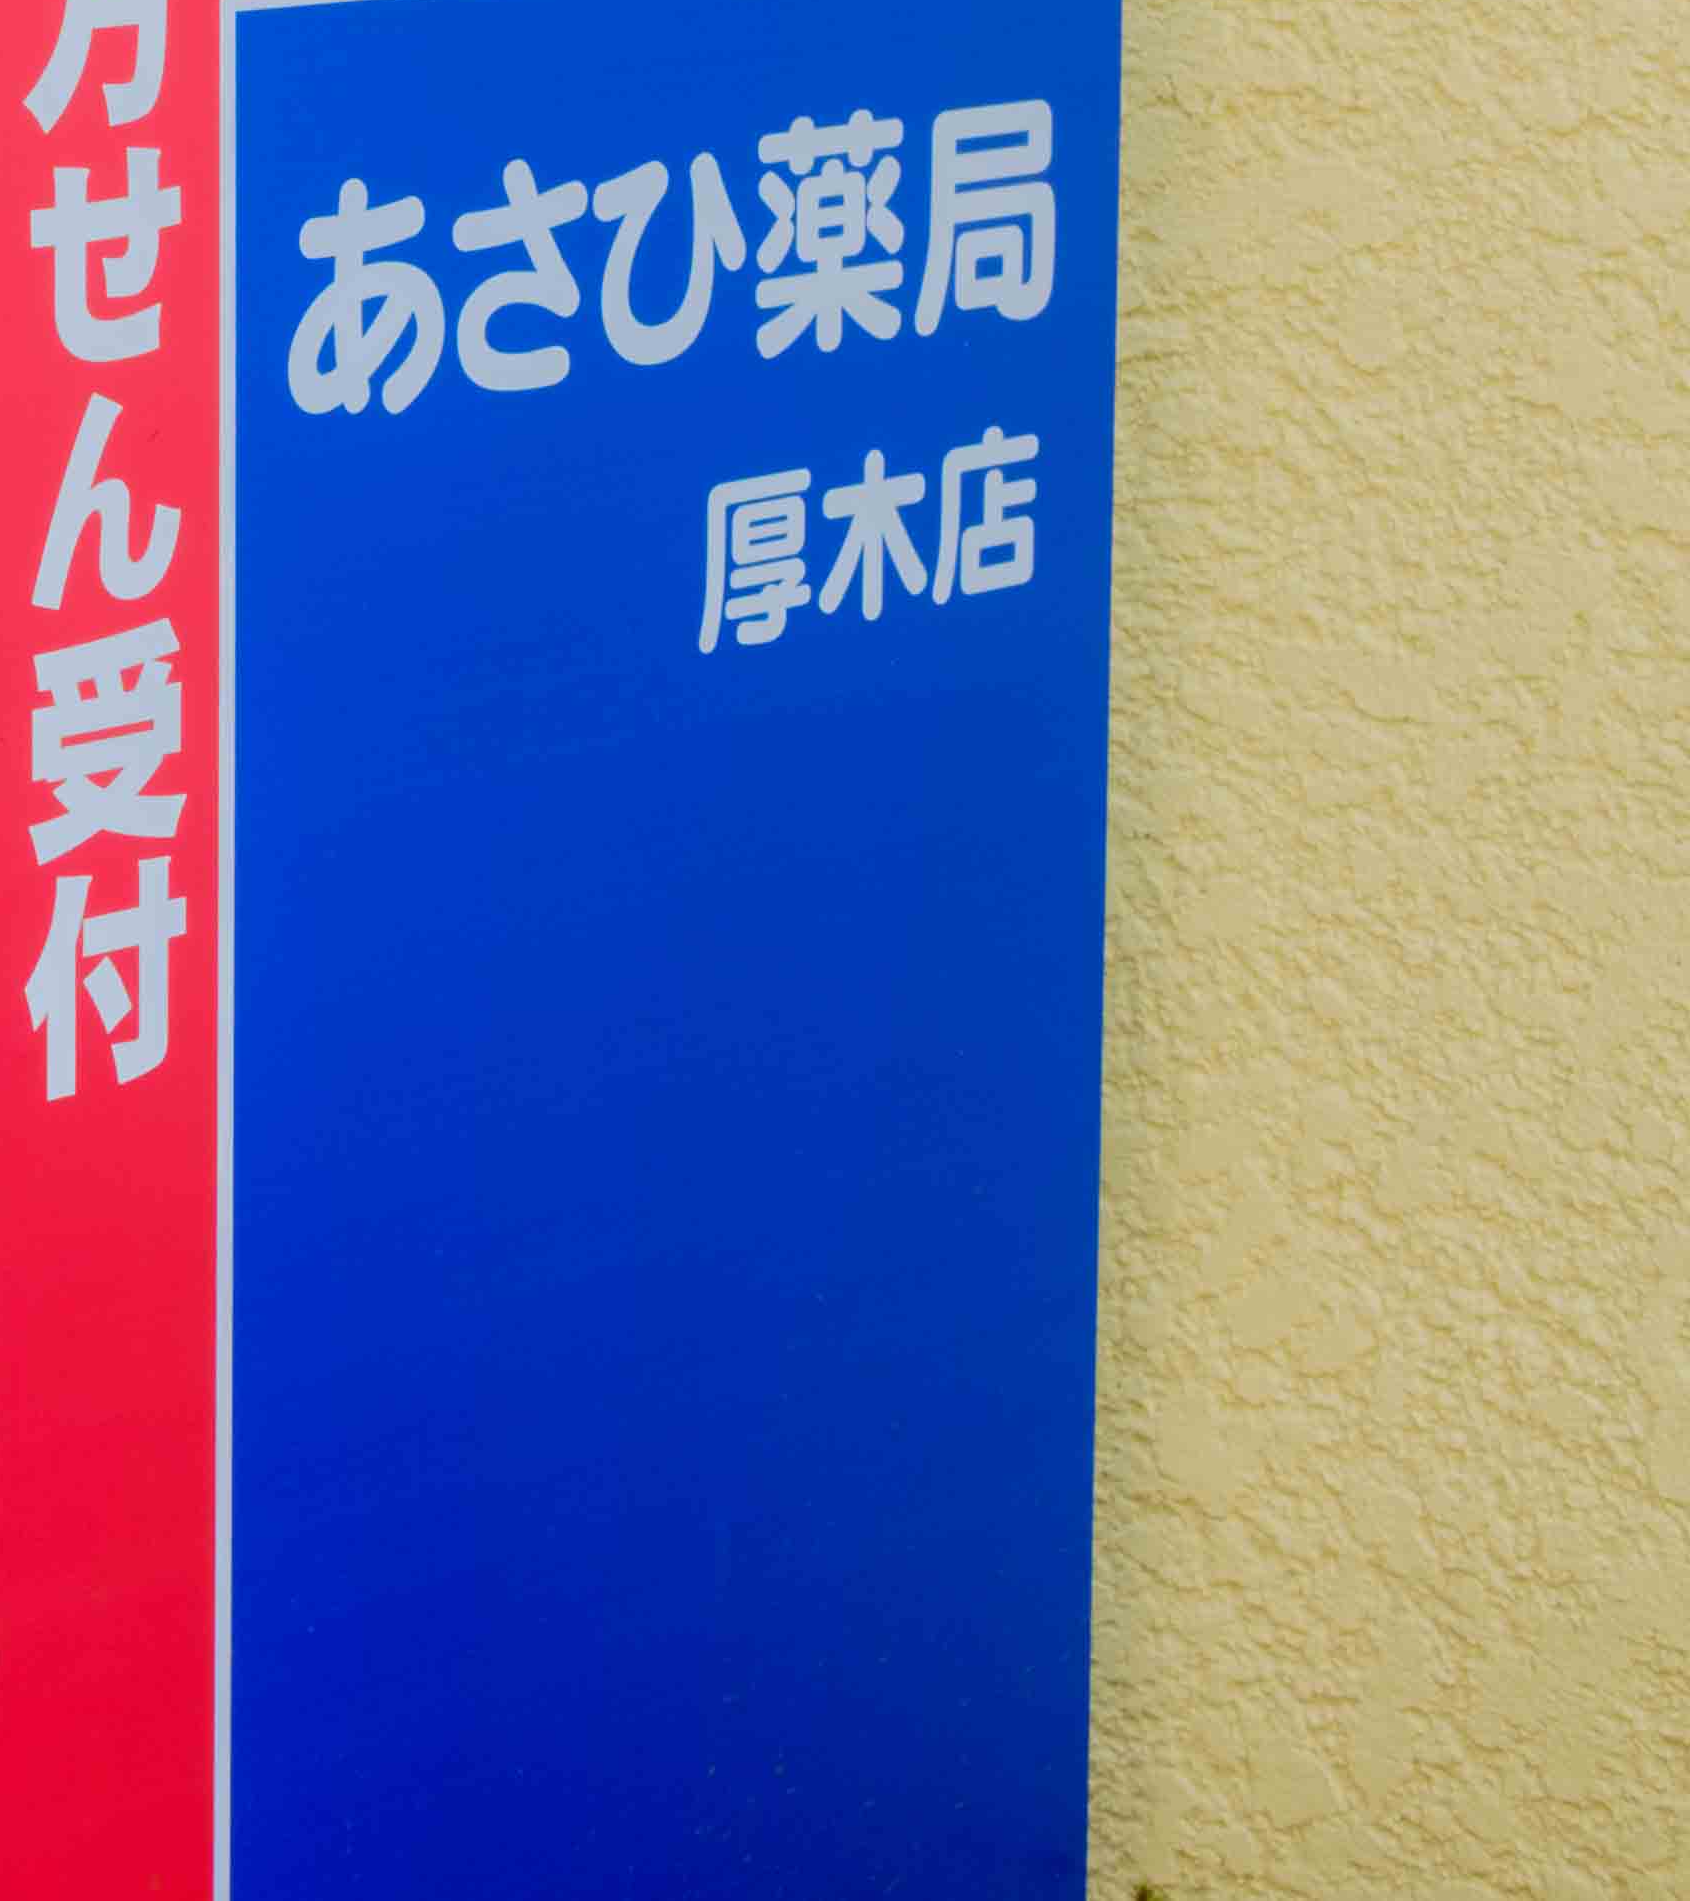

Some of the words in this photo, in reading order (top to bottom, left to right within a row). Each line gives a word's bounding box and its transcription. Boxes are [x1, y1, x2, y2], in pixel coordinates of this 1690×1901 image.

[287, 99, 1057, 416] あさひ薬局
[697, 425, 1040, 654] 厚木店
